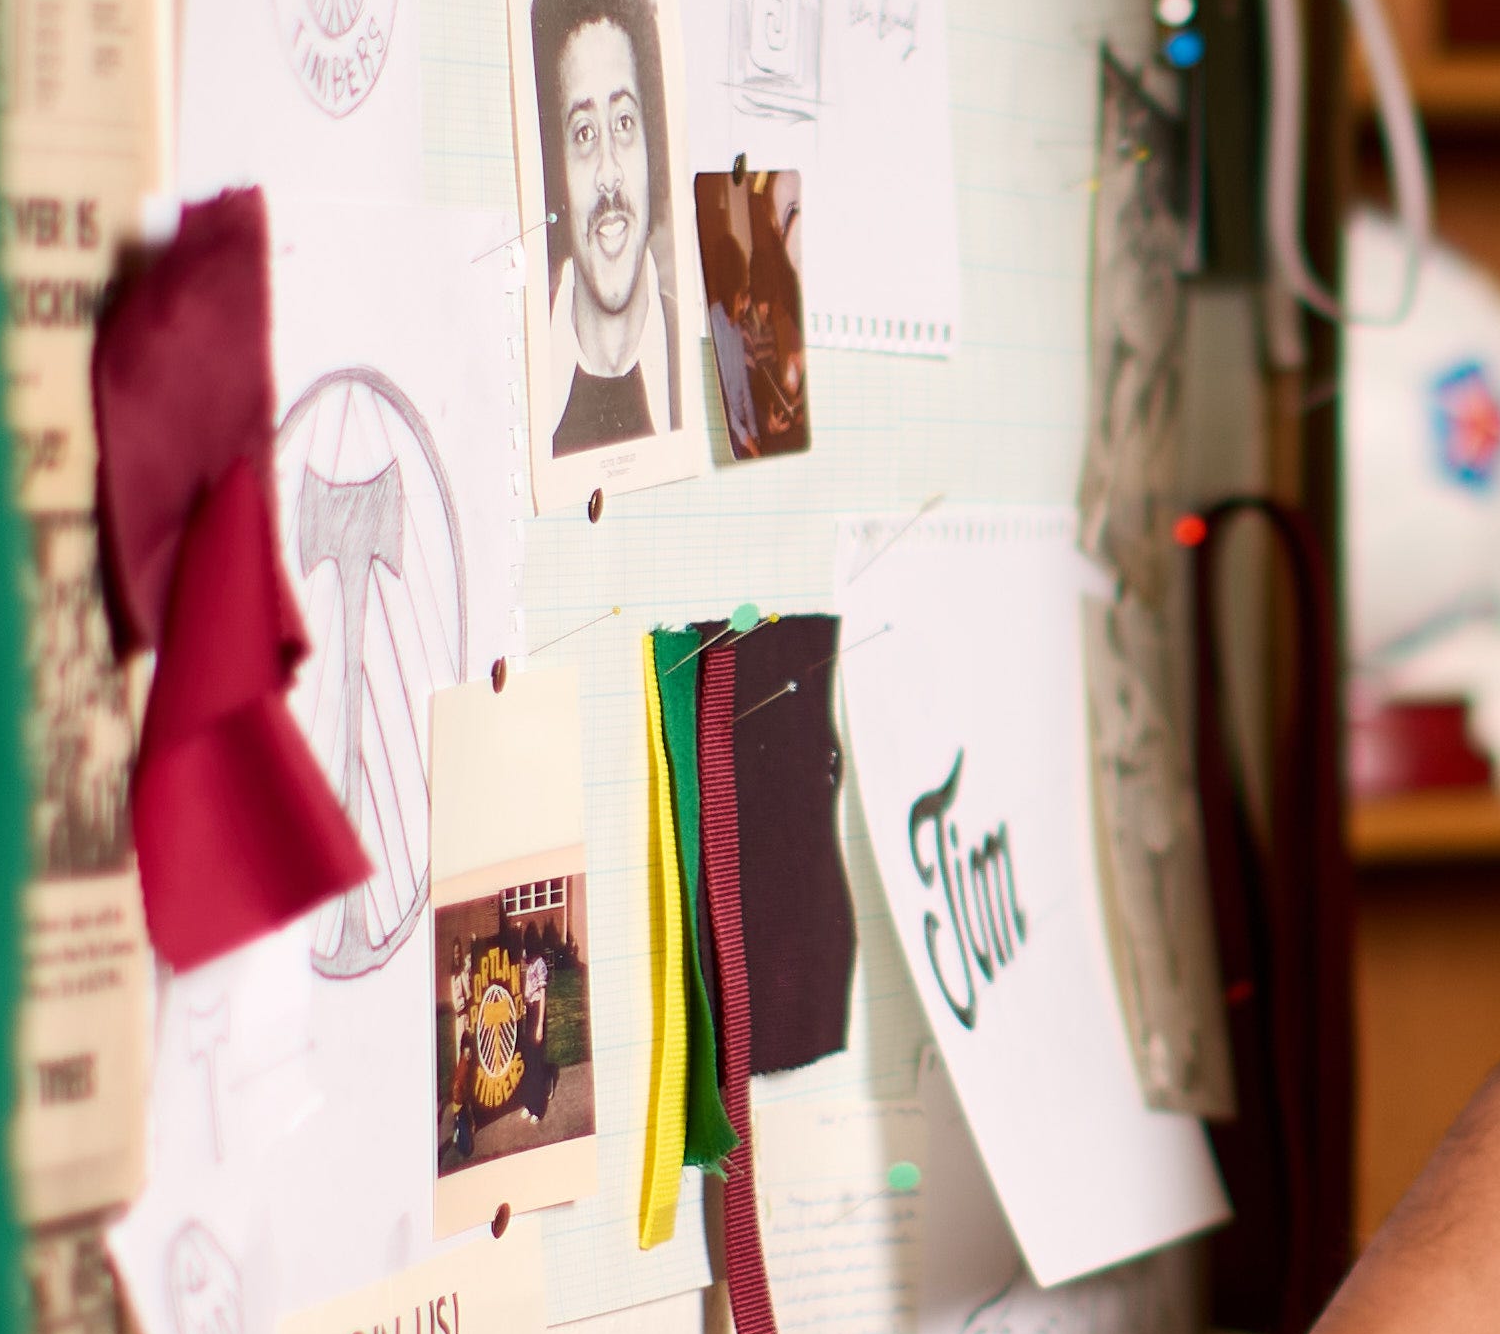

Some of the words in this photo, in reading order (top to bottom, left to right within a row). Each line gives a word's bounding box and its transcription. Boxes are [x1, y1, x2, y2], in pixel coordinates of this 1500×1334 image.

[293, 16, 384, 105] TIMBERS
[908, 747, 1027, 1031] Tim
[474, 1051, 525, 1108] TIMBERS
